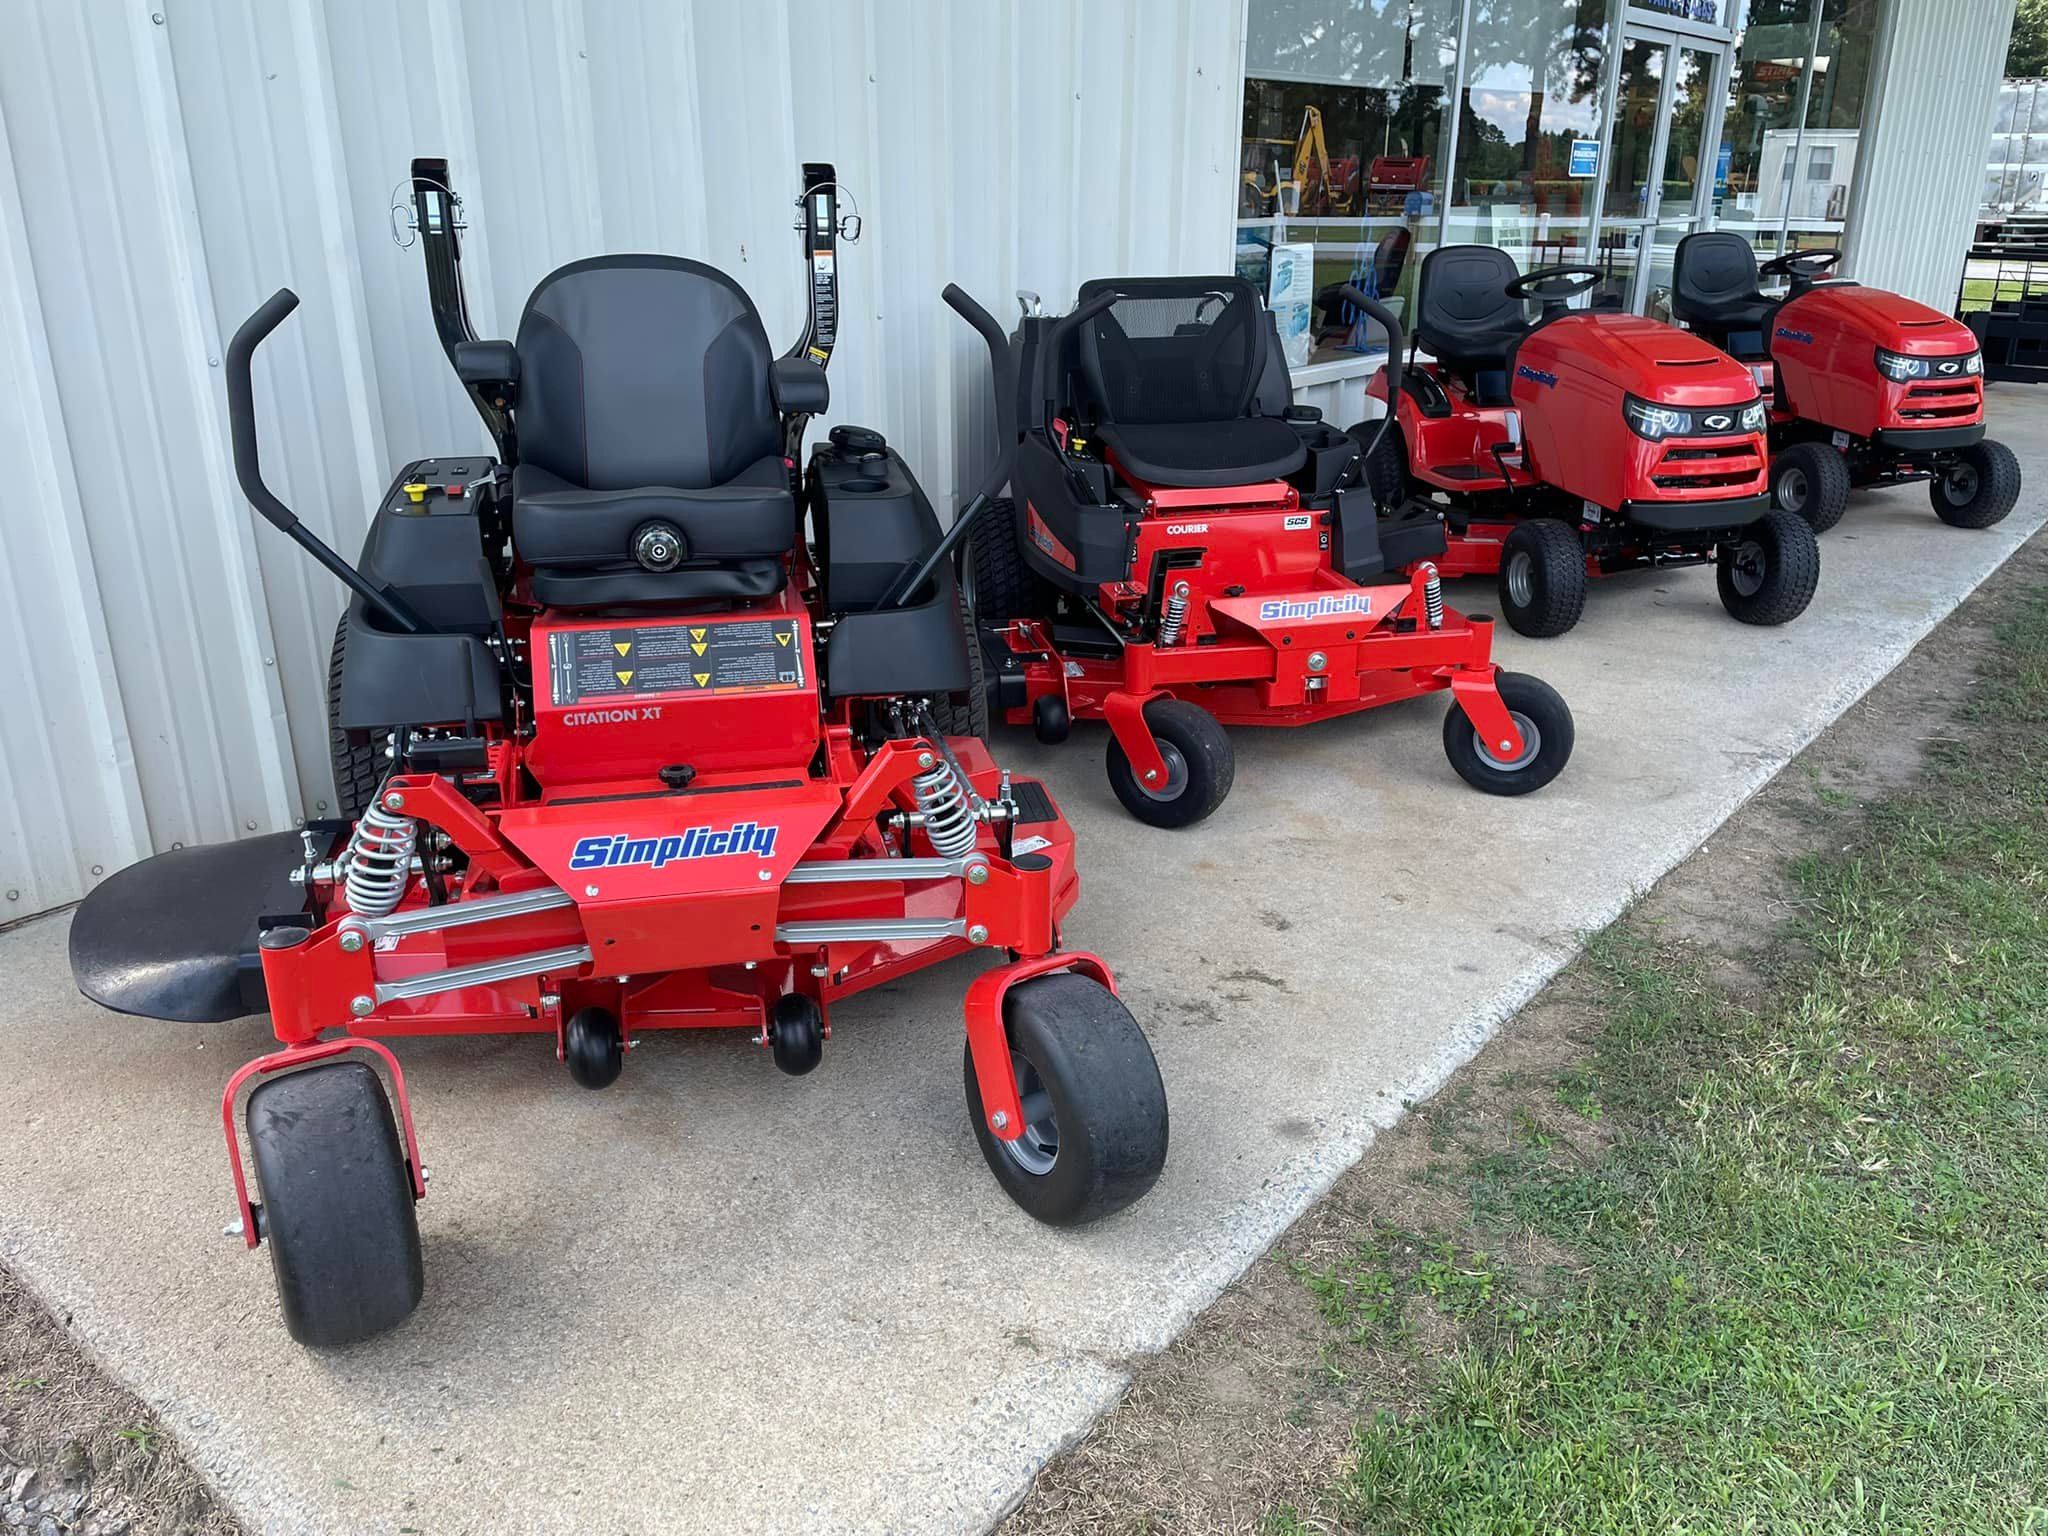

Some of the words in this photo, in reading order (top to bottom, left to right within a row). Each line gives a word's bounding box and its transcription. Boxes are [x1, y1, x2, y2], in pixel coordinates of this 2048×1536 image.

[1758, 64, 1794, 77] STIHL
[1166, 524, 1208, 535] COURIER
[1286, 517, 1309, 526] SCS
[1260, 595, 1371, 620] Simplicity
[563, 709, 637, 726] CITATION
[642, 707, 662, 720] XT
[570, 822, 779, 870] Simplicity
